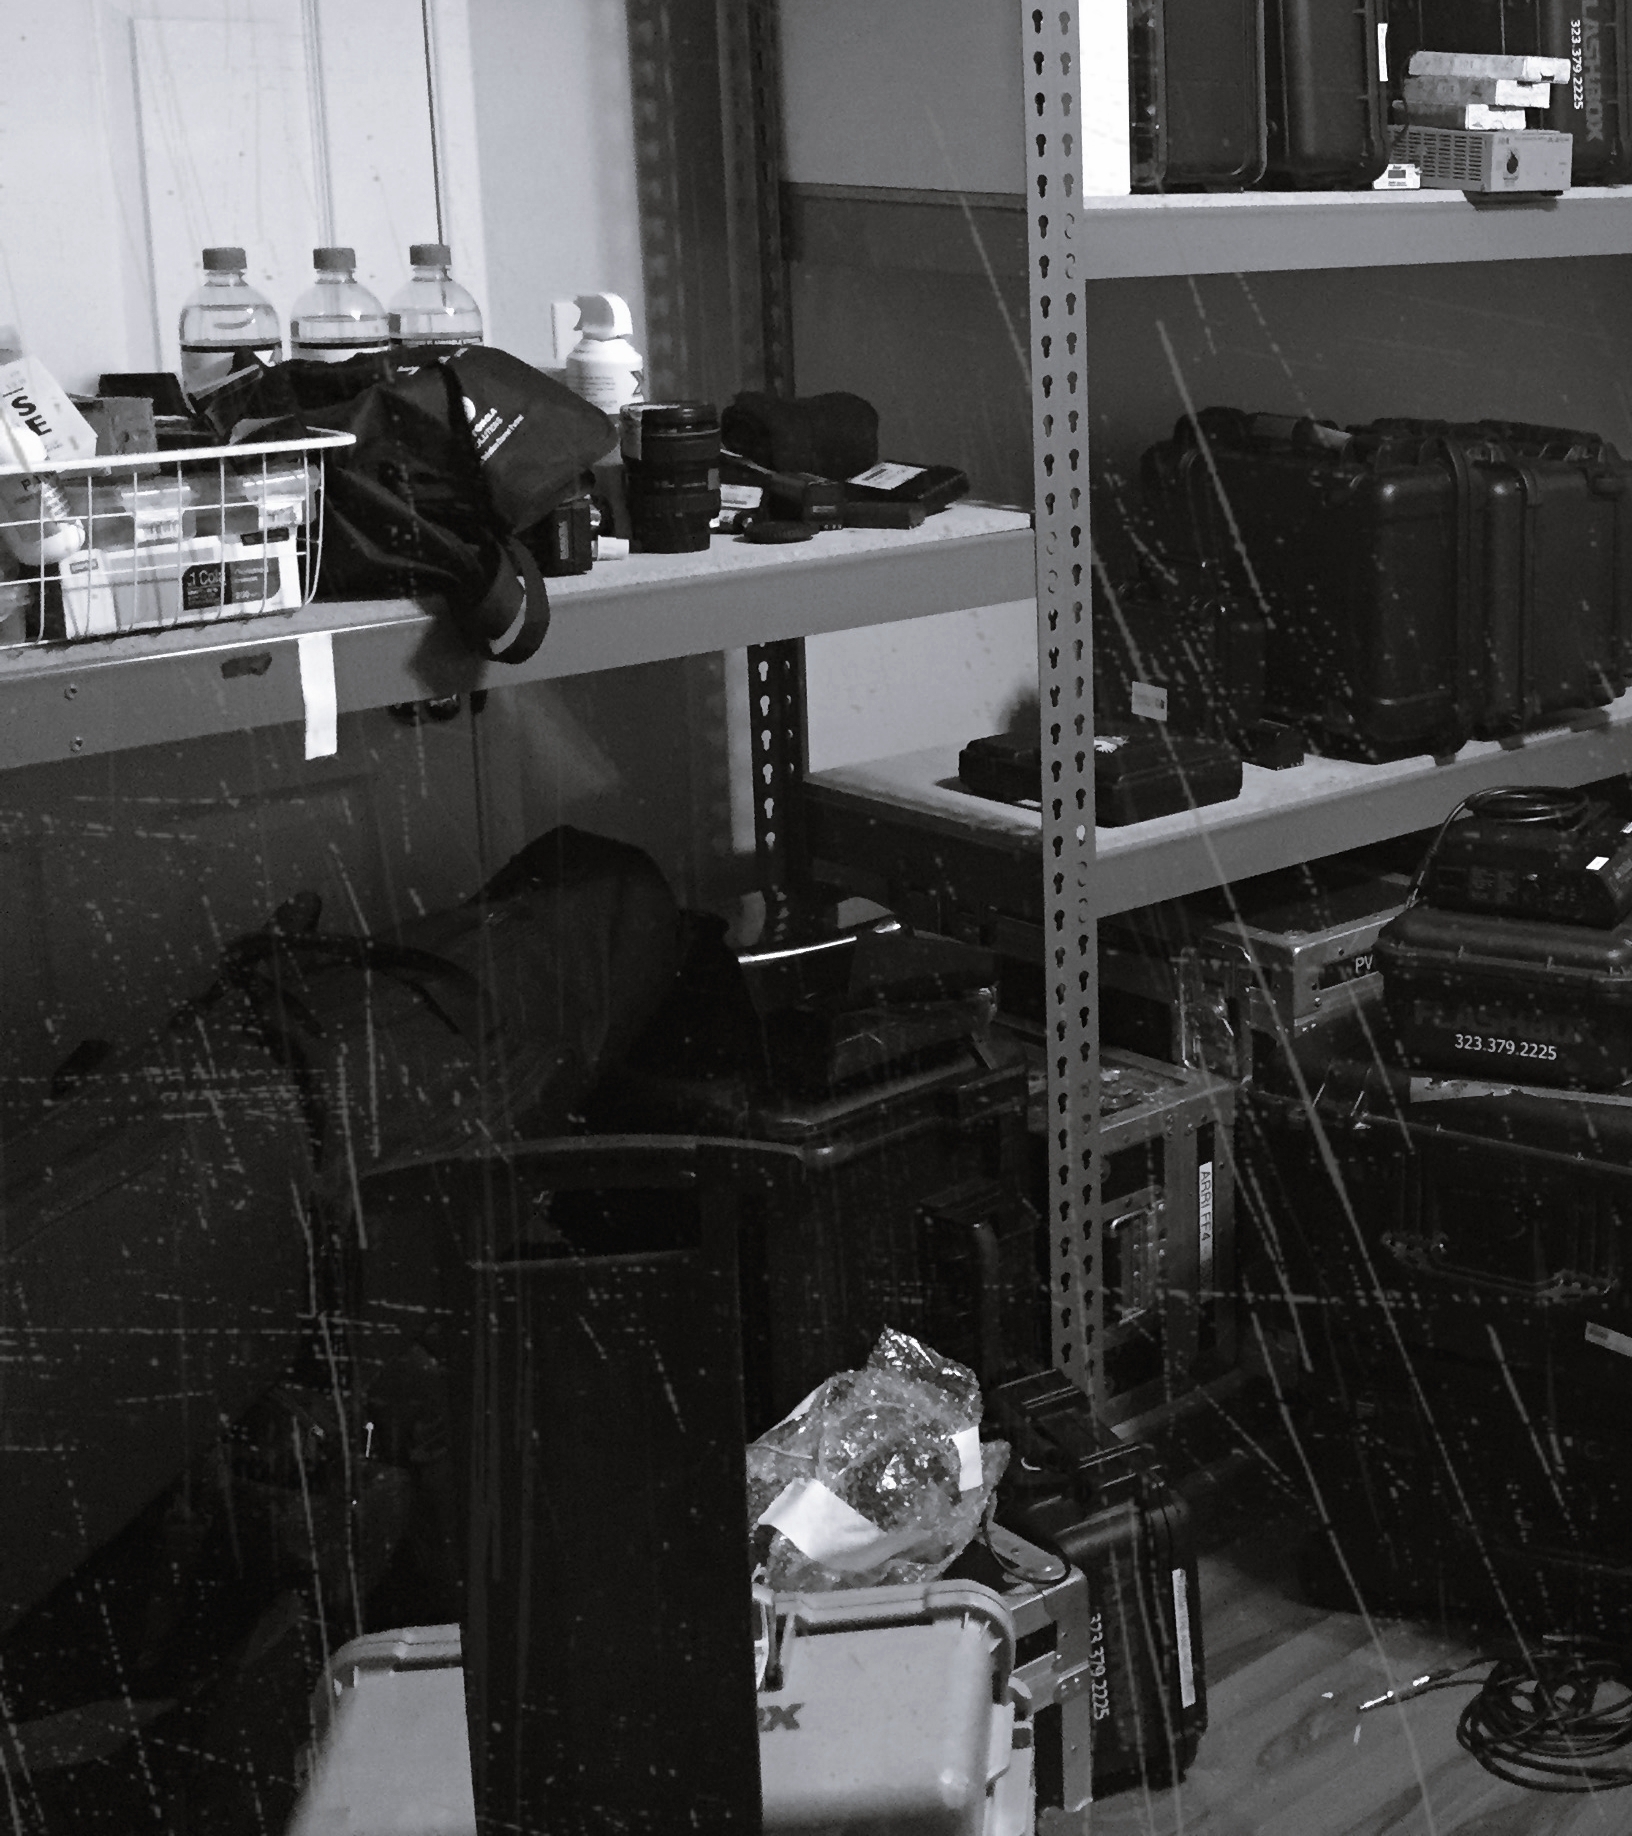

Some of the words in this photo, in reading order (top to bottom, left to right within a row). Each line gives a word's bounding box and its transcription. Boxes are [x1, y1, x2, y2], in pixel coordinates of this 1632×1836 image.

[1570, 19, 1584, 110] 323.379.2225
[1454, 1033, 1558, 1061] 323.379.2225
[1200, 1170, 1213, 1209] ARRI
